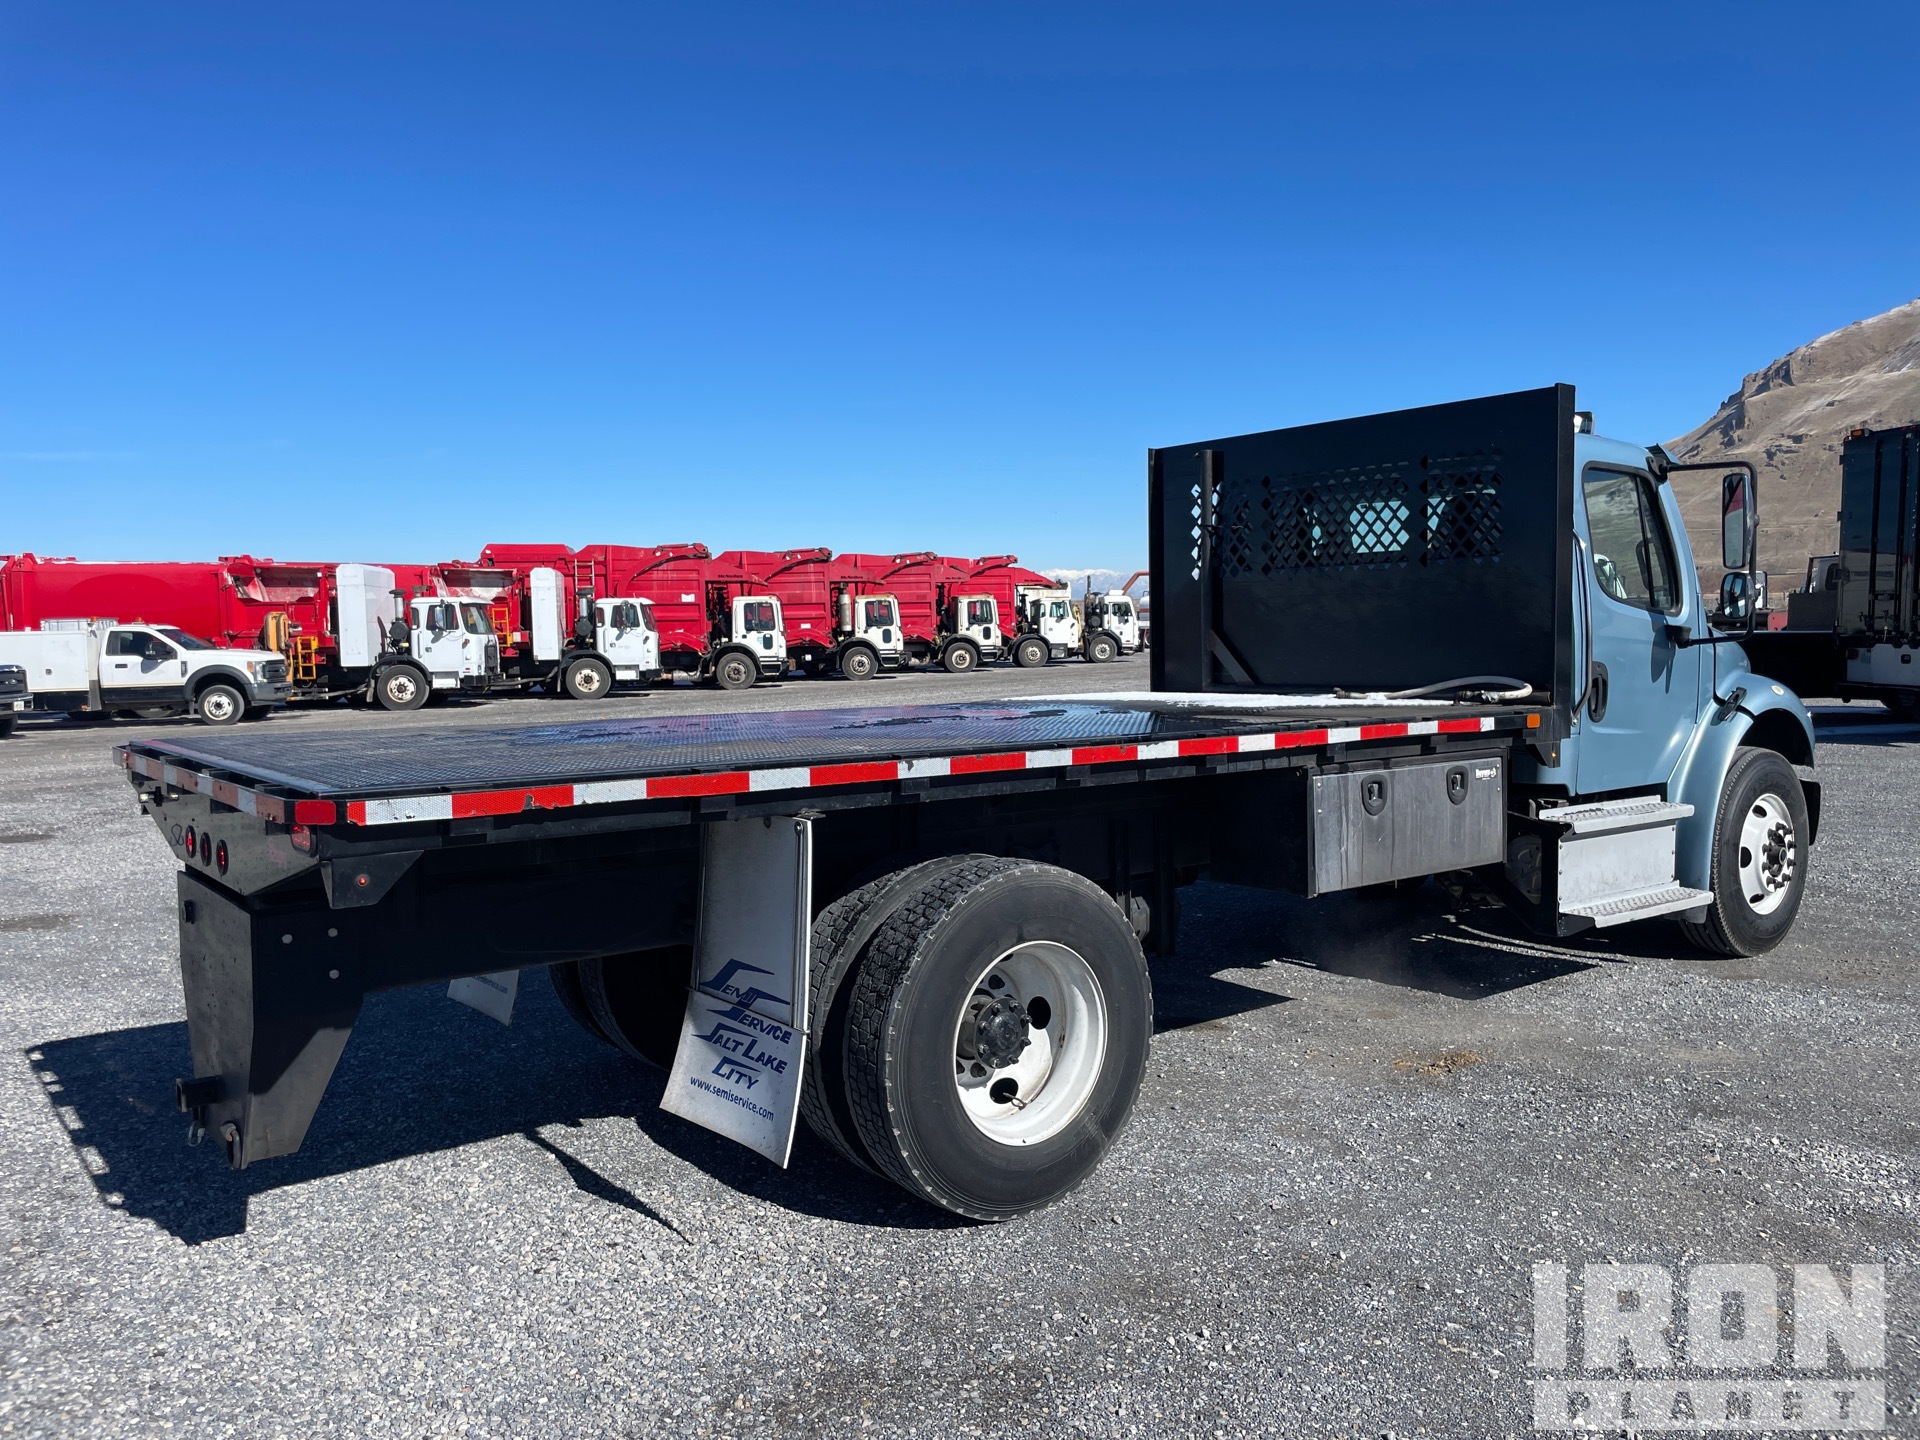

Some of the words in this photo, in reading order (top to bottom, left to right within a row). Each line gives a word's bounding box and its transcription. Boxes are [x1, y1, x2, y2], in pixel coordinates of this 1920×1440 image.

[706, 986, 792, 1045] SERVICE
[691, 1022, 758, 1052] SALT
[741, 1036, 788, 1075] LAKE
[711, 1056, 761, 1090] CITY
[690, 1076, 775, 1122] www.semiservice.com
